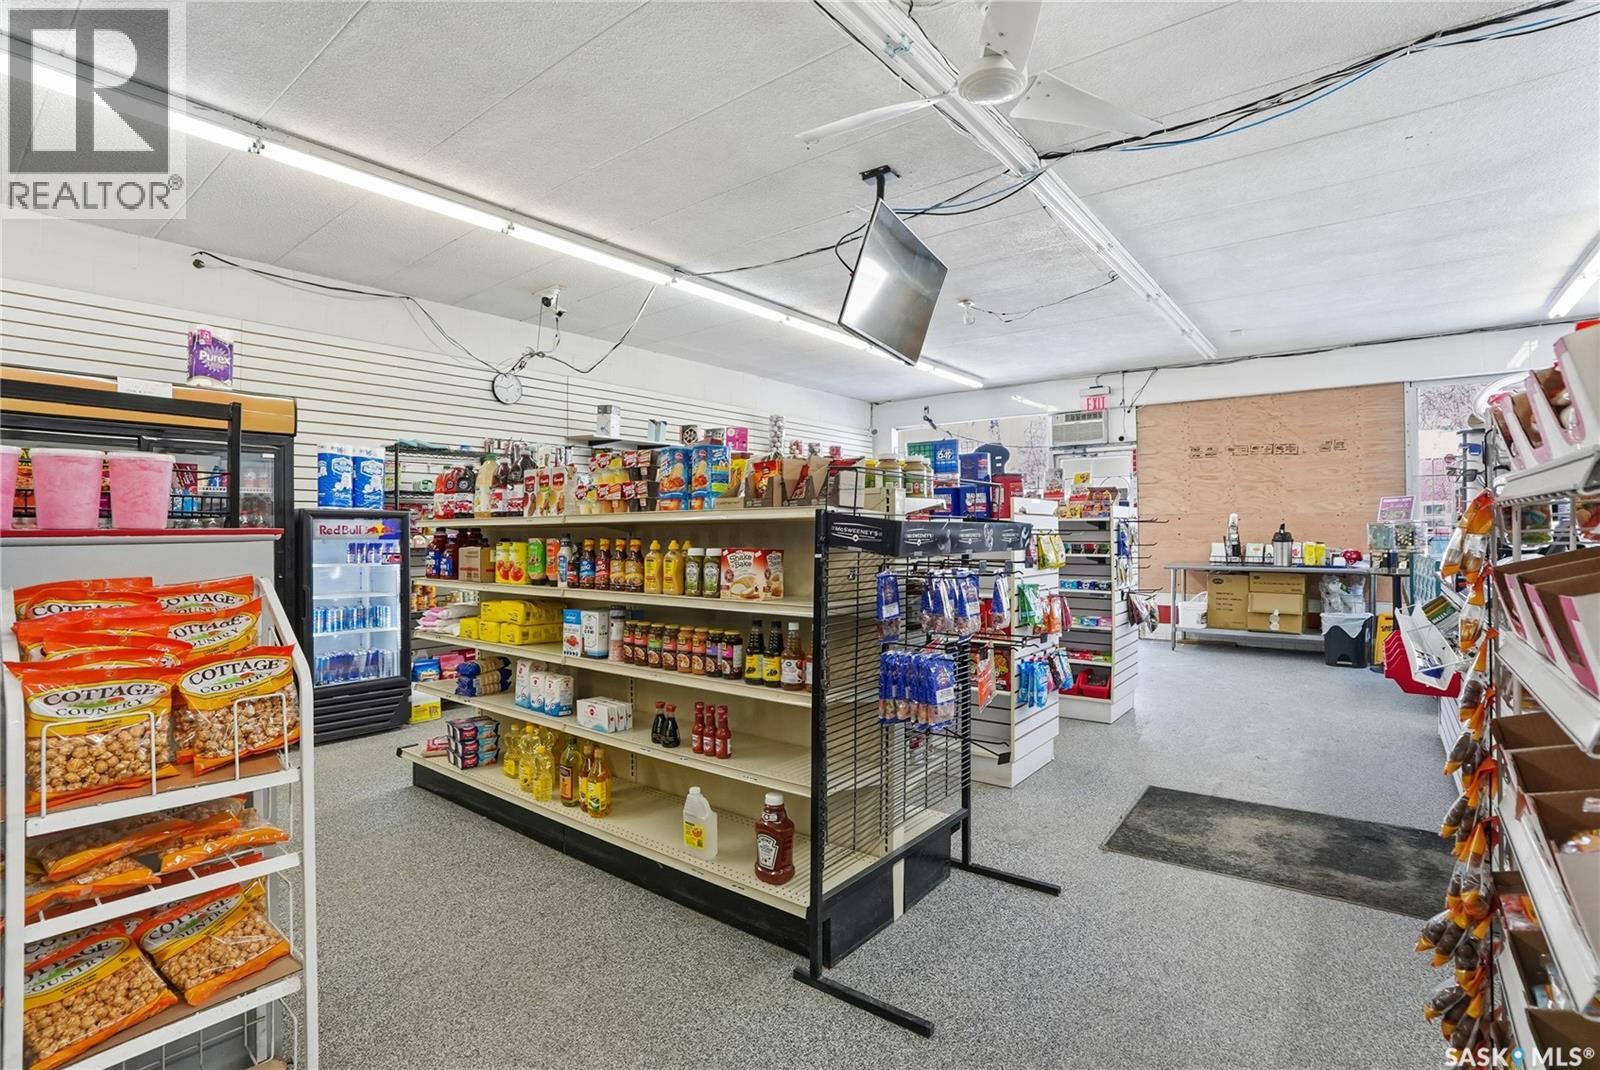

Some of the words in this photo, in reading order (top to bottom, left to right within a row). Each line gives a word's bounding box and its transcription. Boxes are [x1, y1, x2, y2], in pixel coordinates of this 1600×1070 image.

[199, 350, 231, 366] Purex
[1086, 396, 1106, 412] EXIT
[319, 525, 341, 535] Red
[342, 525, 362, 535] Bull
[729, 554, 753, 563] Shake
[189, 659, 281, 685] COTTAGE
[200, 671, 273, 694] COUNTRY
[43, 684, 156, 706] COTTAGE
[56, 697, 144, 716] COUNTRY
